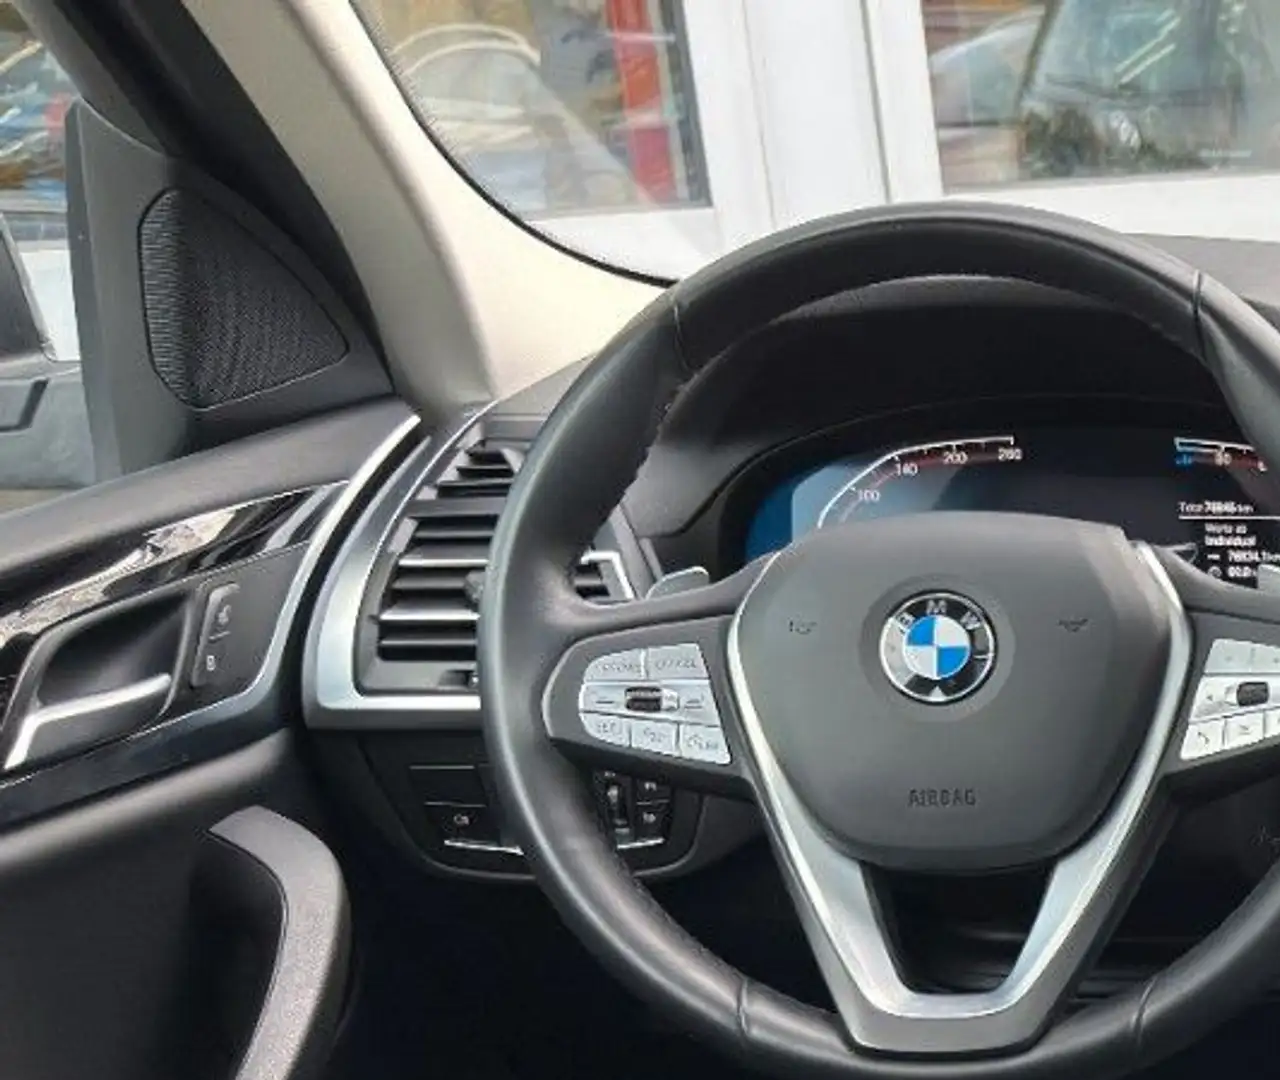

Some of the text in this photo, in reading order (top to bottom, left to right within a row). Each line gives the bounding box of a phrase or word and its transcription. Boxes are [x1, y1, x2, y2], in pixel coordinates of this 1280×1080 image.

[943, 452, 968, 465] 200
[858, 489, 880, 502] 100
[893, 599, 984, 637] BMW
[908, 787, 978, 807] AIRBAG
